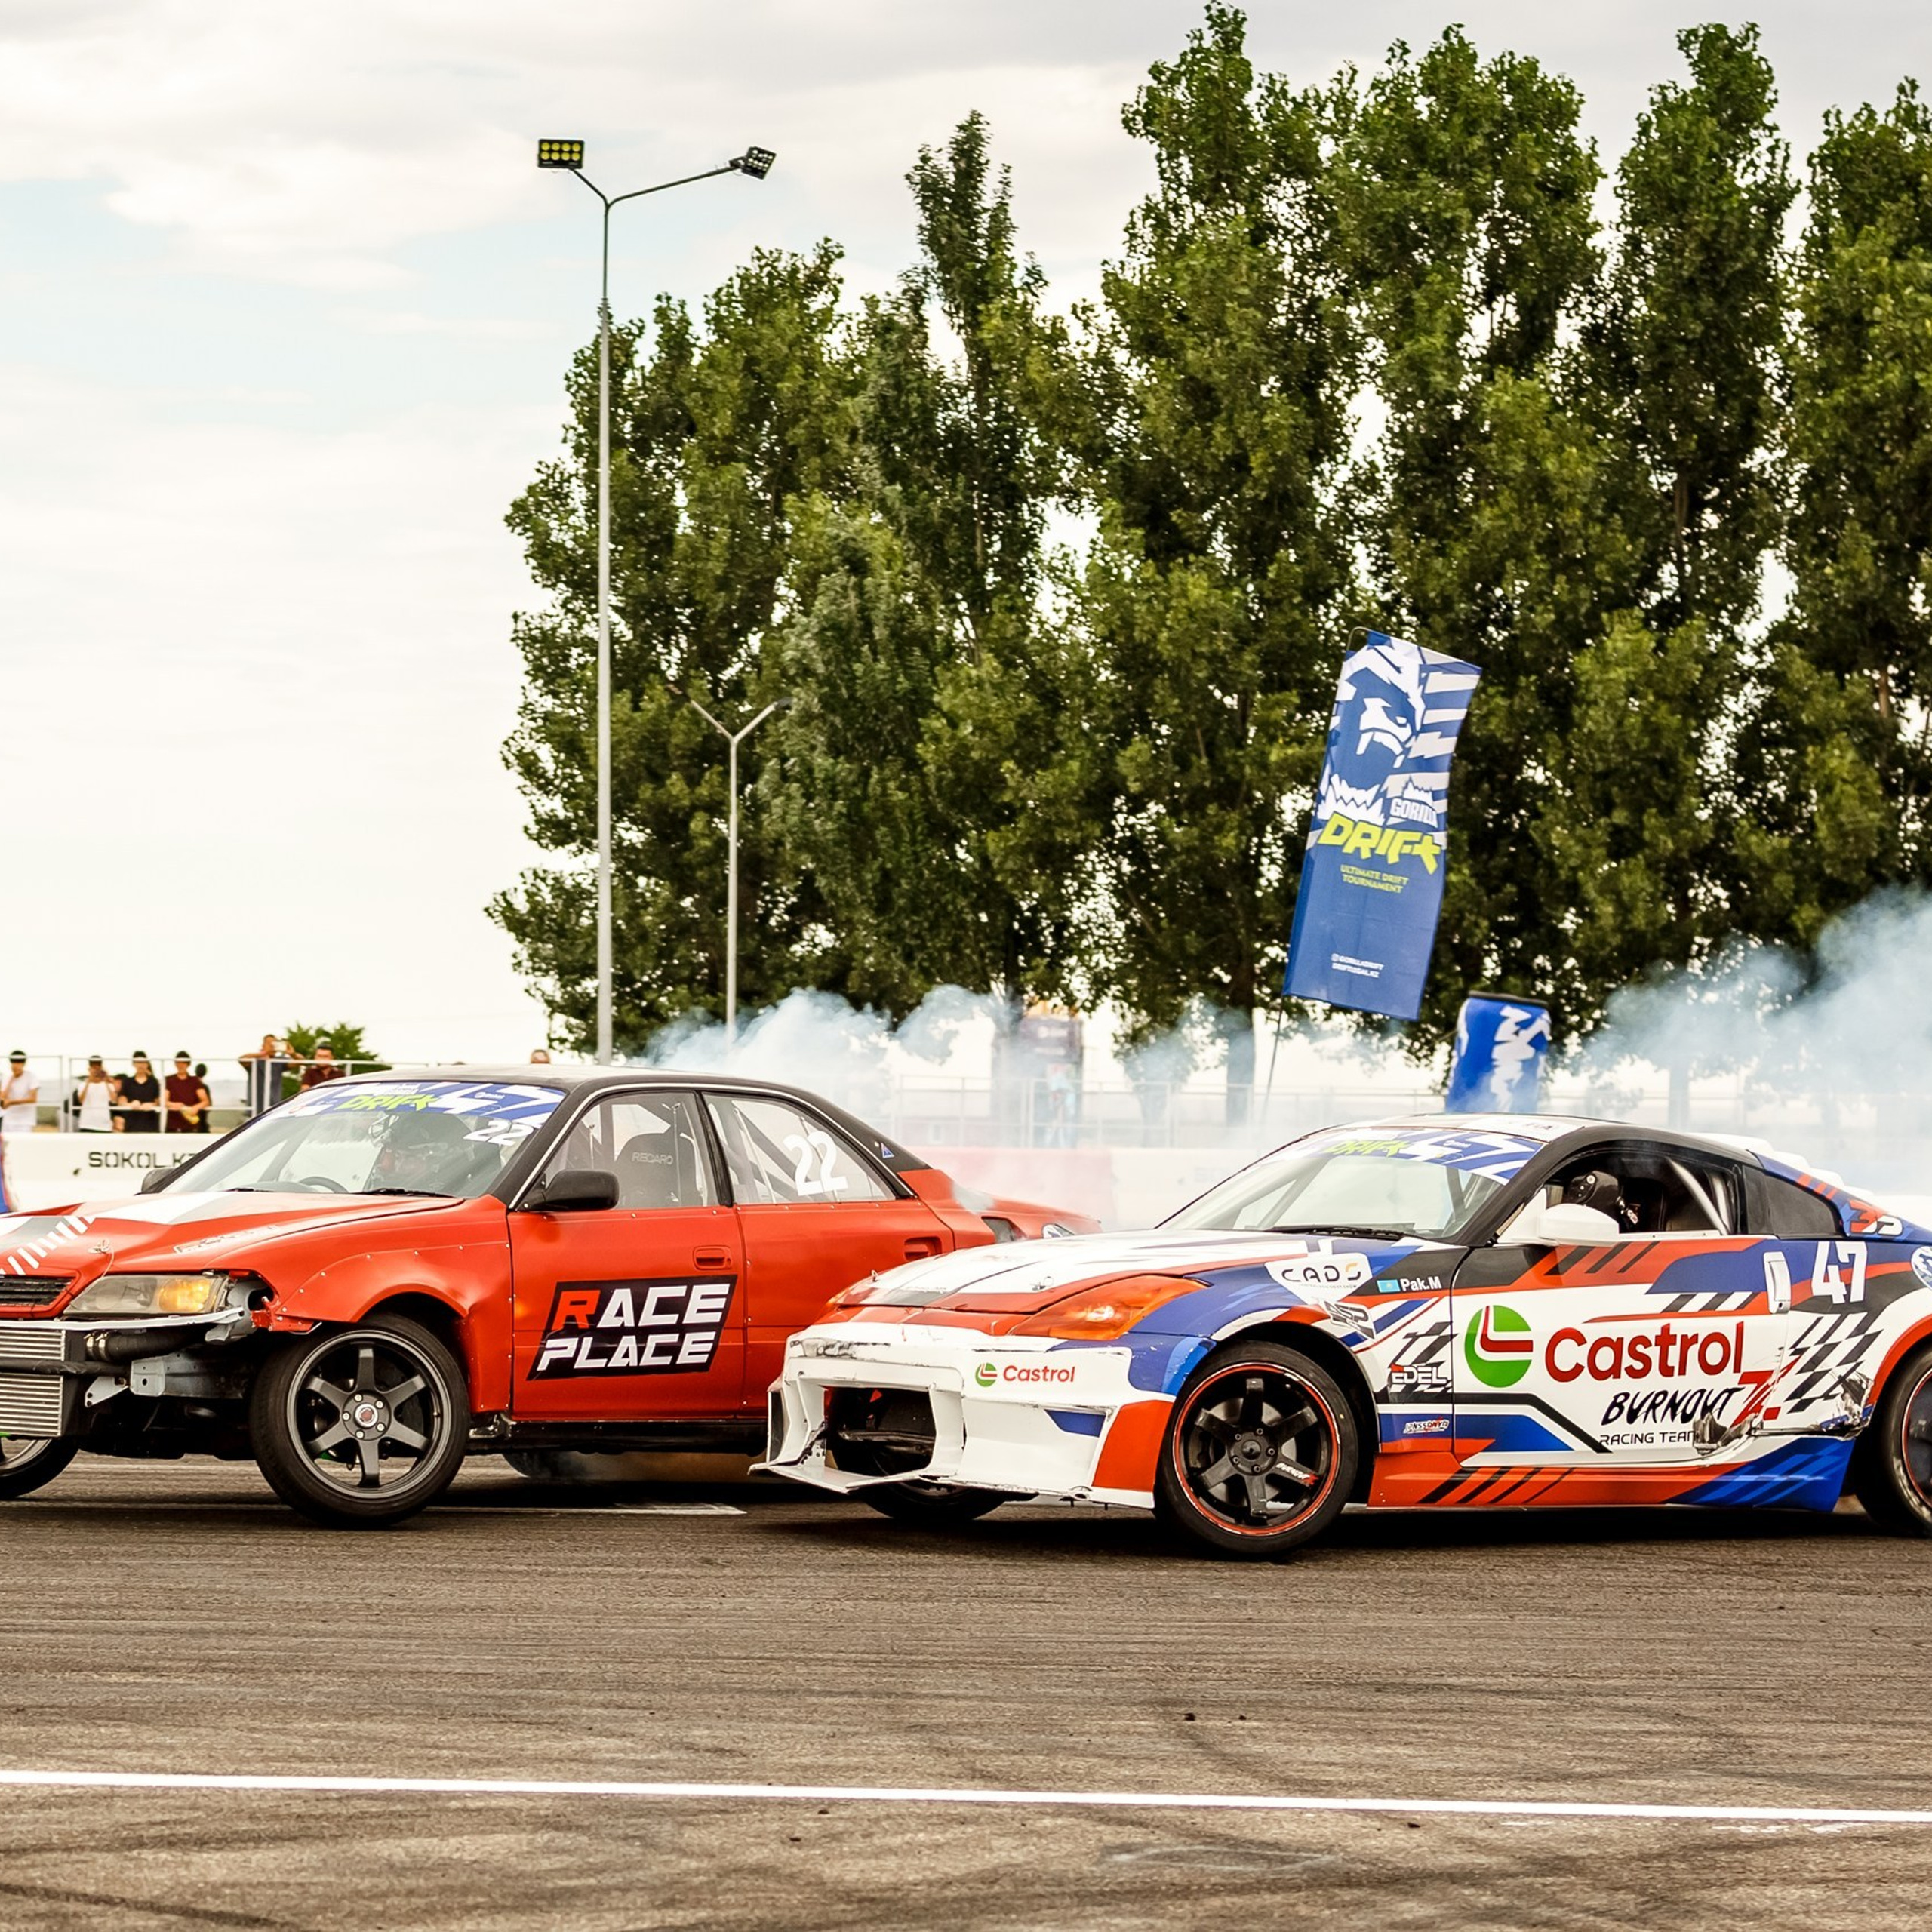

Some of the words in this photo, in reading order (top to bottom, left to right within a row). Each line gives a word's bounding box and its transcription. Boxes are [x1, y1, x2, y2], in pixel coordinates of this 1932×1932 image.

[1382, 872, 1410, 886] DRIFT
[463, 1120, 534, 1146] 22
[632, 1152, 674, 1165] RECARO
[783, 1131, 848, 1196] 22
[1400, 1276, 1442, 1291] Pak.M
[1811, 1241, 1868, 1304] 47
[551, 1284, 730, 1331] RACE
[537, 1331, 716, 1371] PLACE
[1545, 1321, 1744, 1383] Castrol
[1003, 1365, 1075, 1383] Castrol
[1601, 1386, 1746, 1426] BURNOUT
[1600, 1432, 1654, 1446] RACING
